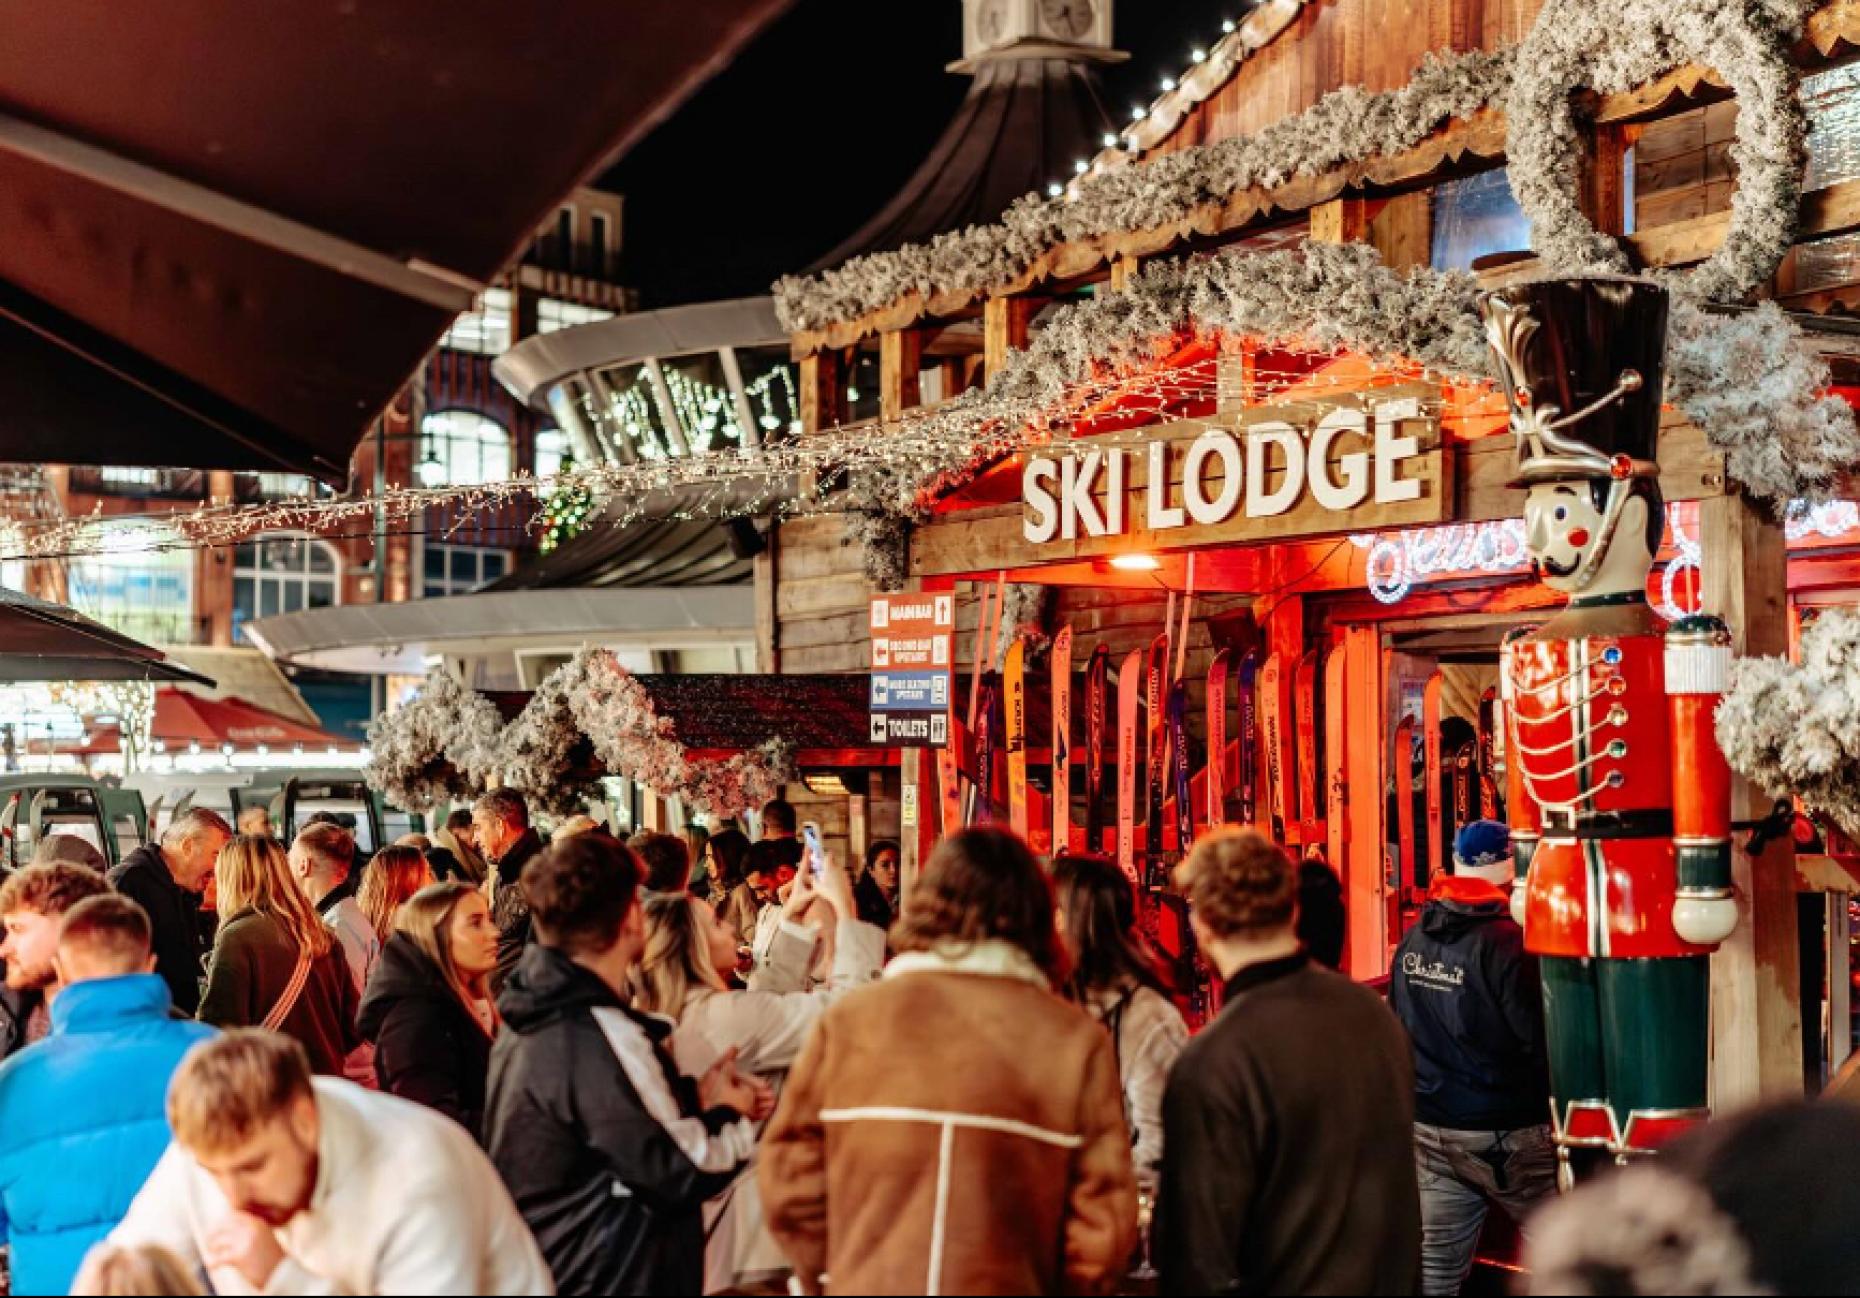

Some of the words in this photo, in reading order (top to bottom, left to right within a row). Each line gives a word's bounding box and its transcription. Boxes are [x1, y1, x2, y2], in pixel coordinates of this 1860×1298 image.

[1022, 446, 1123, 544] SKI
[1147, 398, 1422, 530] LODGE
[887, 719, 929, 738] TOILETS
